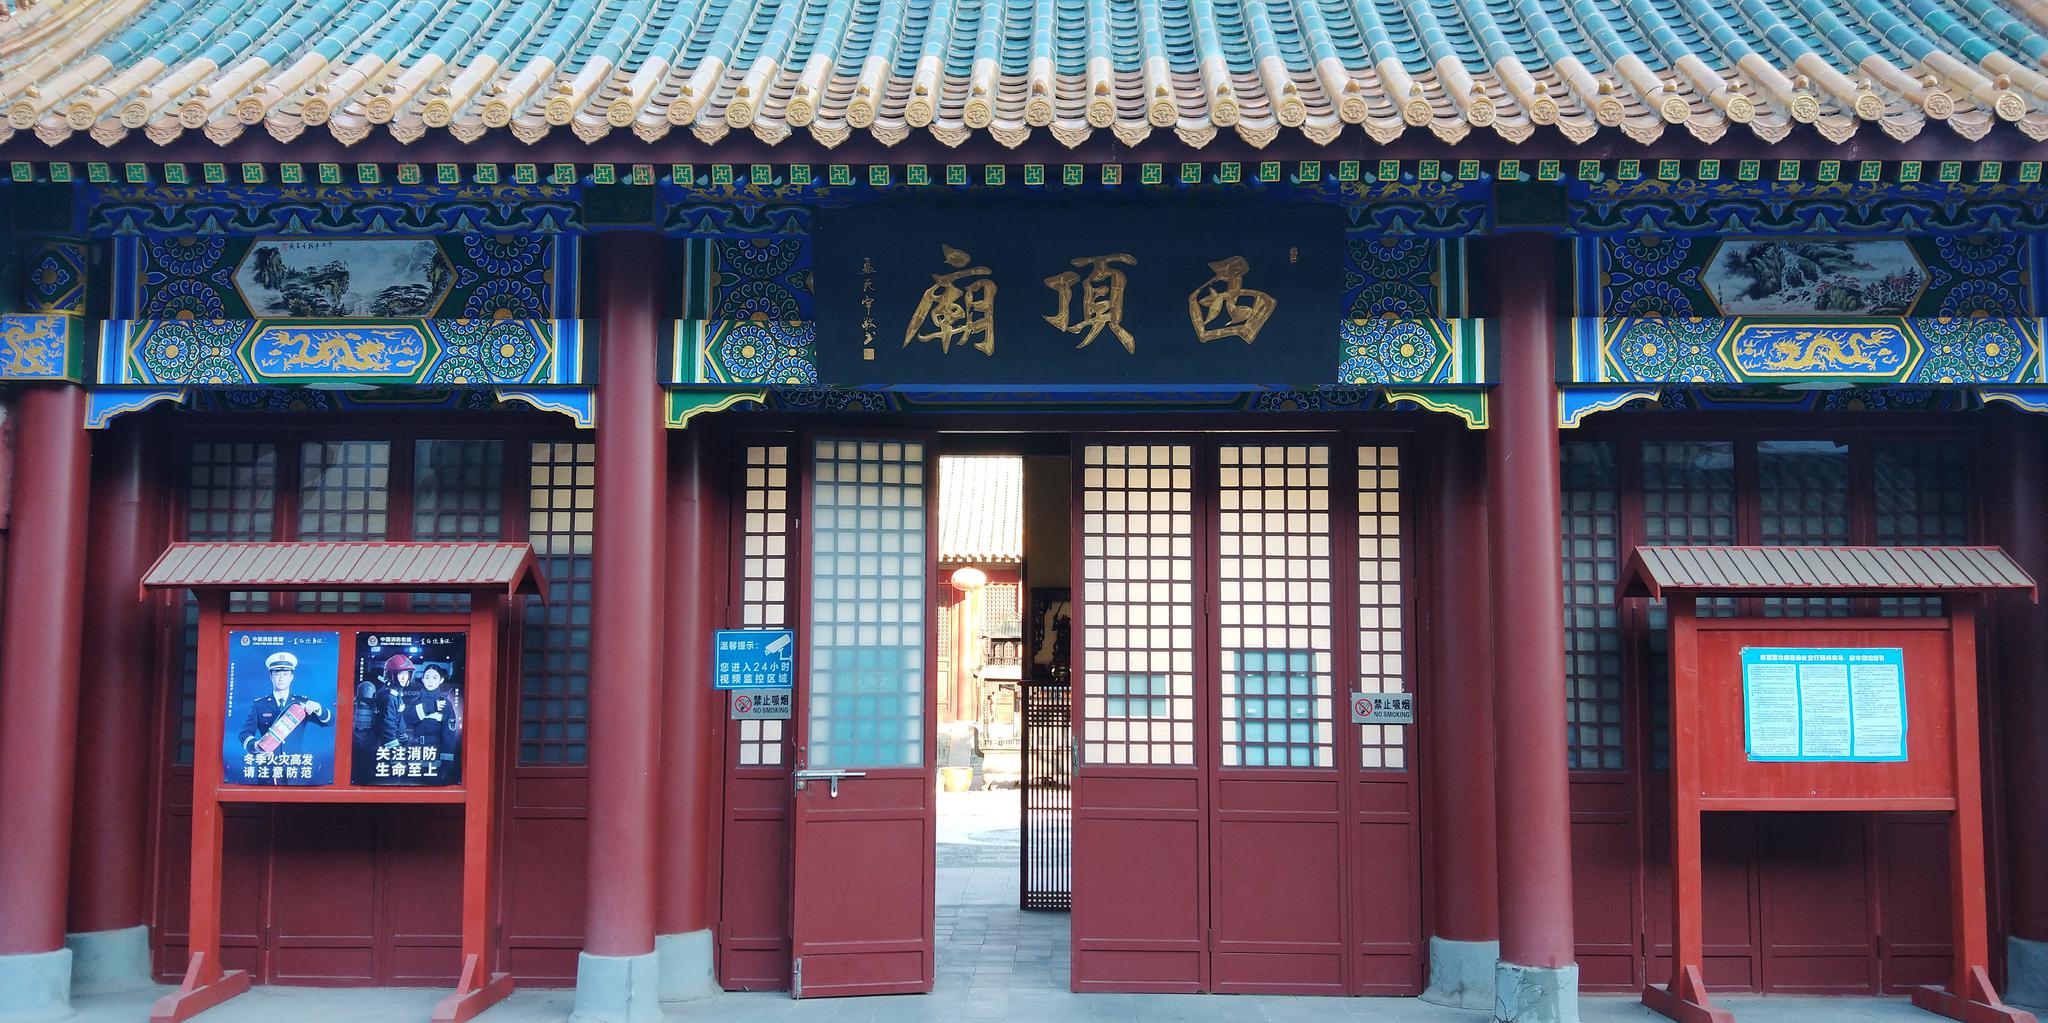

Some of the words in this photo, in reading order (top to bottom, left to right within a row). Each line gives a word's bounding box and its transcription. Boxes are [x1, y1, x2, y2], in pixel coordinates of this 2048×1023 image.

[720, 662, 790, 672] 您进入24小时
[720, 674, 788, 684] 视频监控区域
[753, 694, 789, 706] 禁止吸烟
[1374, 698, 1410, 710] 禁止吸烟
[243, 752, 313, 766] 冬季火灾高发
[375, 746, 437, 761] 关注消防
[243, 766, 312, 779] 请注意防范
[375, 762, 438, 777] 生命至上
